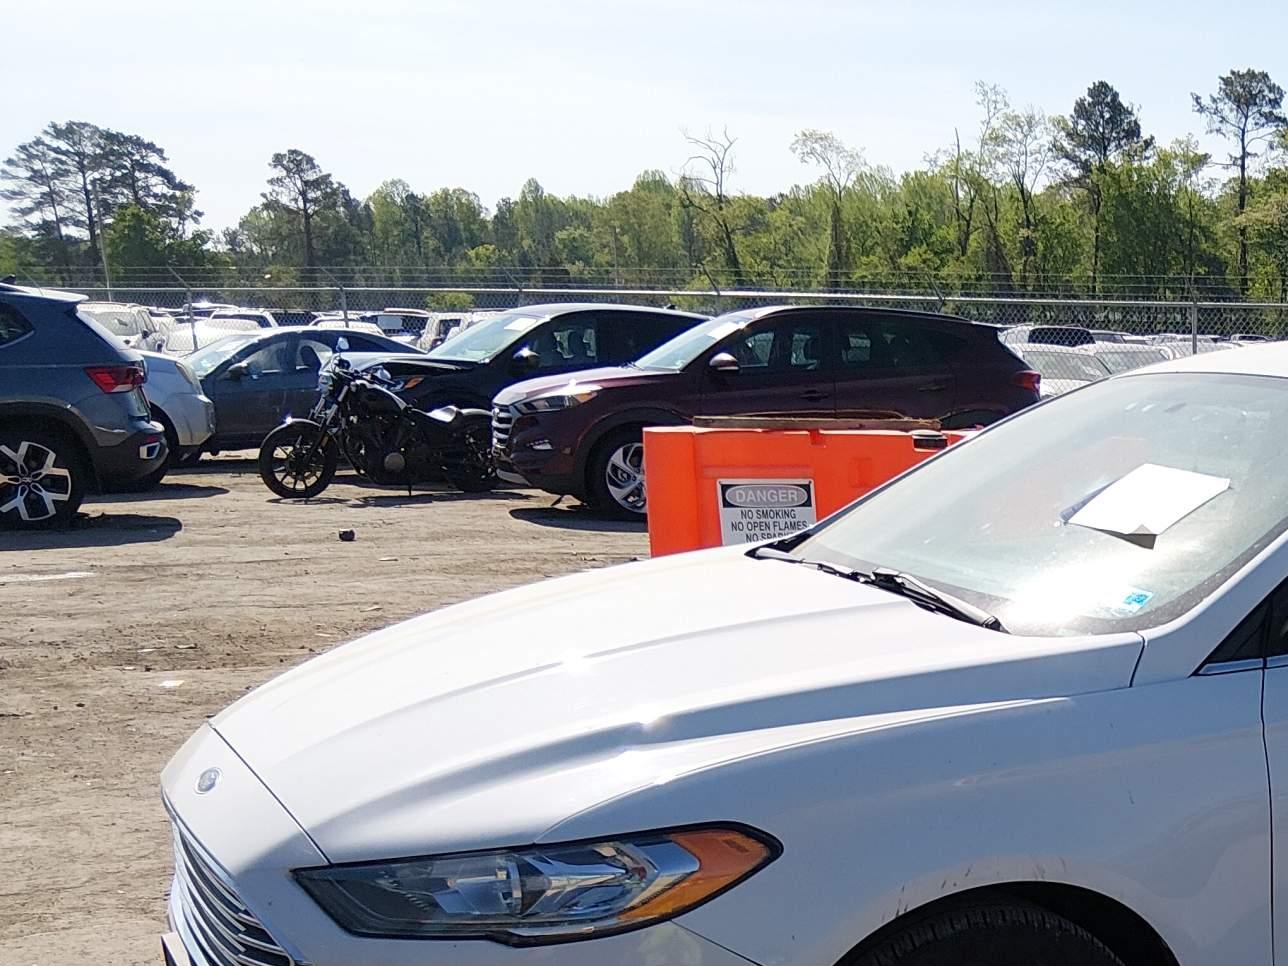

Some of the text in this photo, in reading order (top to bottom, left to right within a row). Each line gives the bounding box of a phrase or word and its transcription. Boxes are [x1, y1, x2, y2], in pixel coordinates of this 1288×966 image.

[735, 489, 798, 502] DANGER
[740, 508, 796, 520] NO SMOKING
[731, 520, 808, 532] NO OPEN FLAMES
[746, 532, 759, 543] NO
